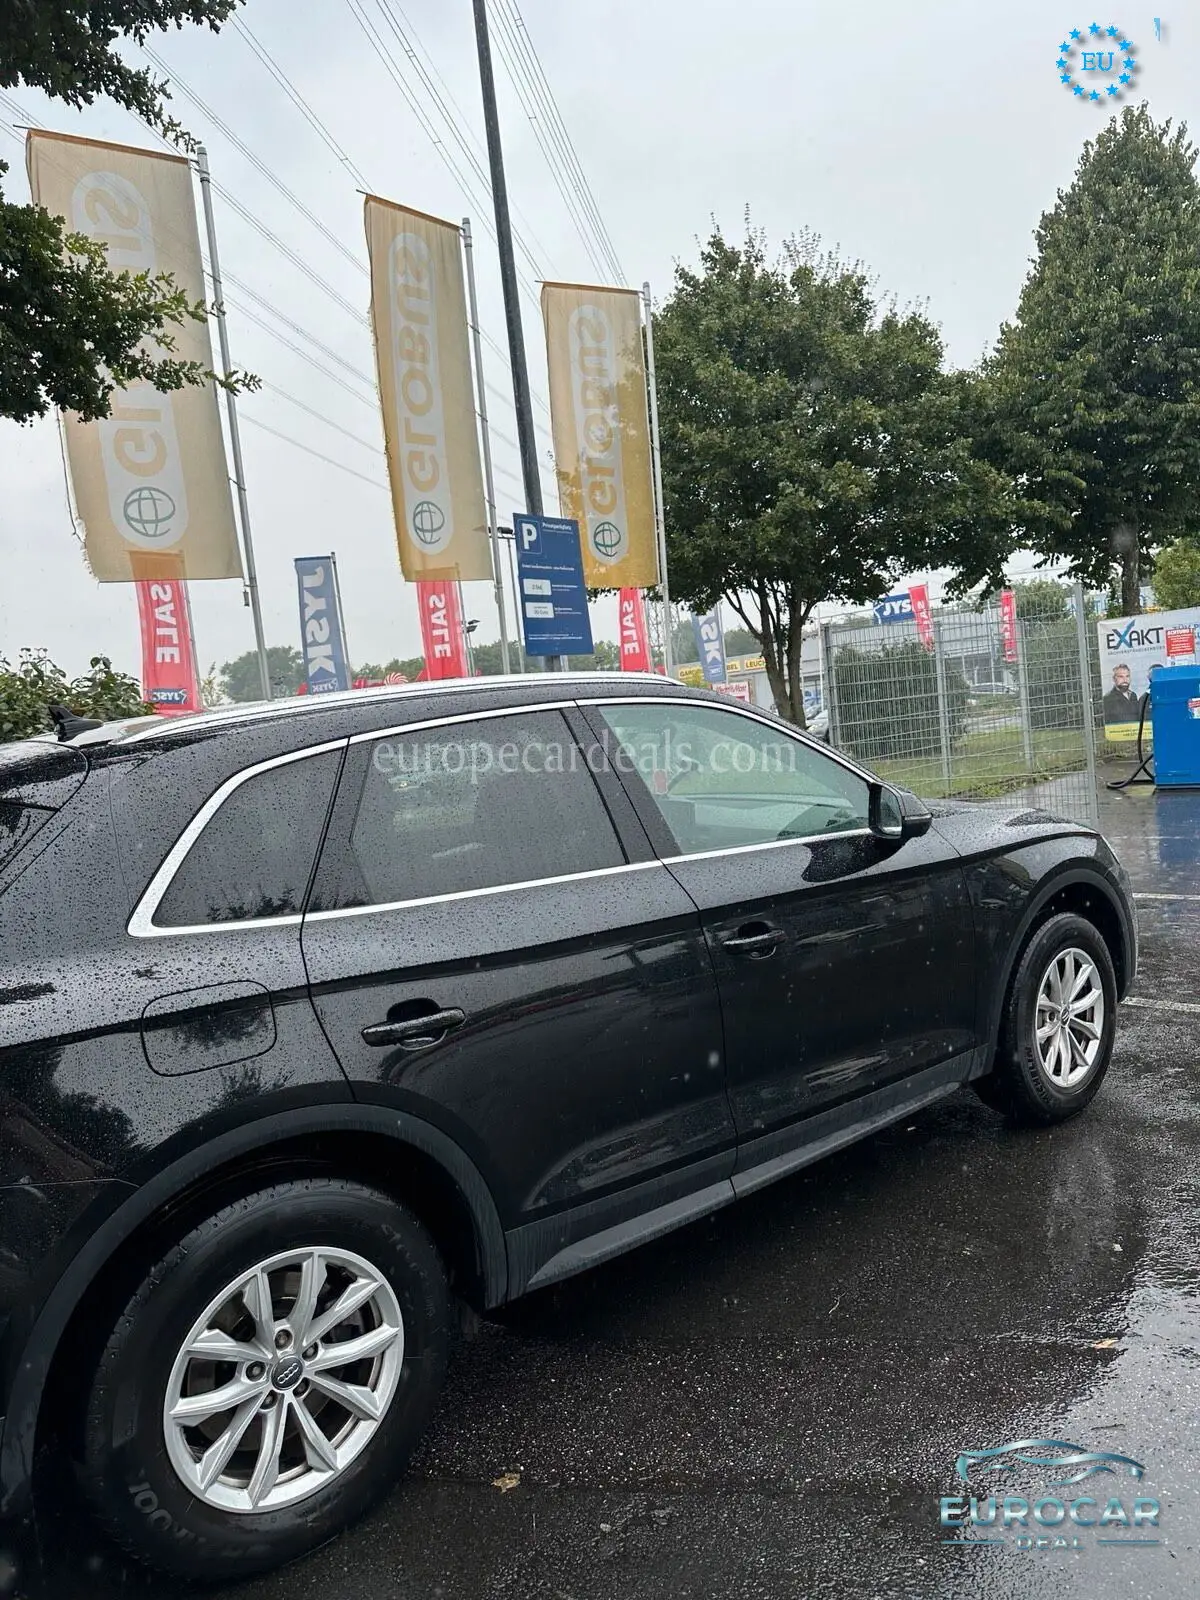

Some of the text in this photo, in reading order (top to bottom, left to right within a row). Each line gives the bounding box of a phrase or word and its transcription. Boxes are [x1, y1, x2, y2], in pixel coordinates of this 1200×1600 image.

[522, 523, 537, 550] P
[883, 599, 911, 616] JYS
[1106, 620, 1164, 650] EXAKT
